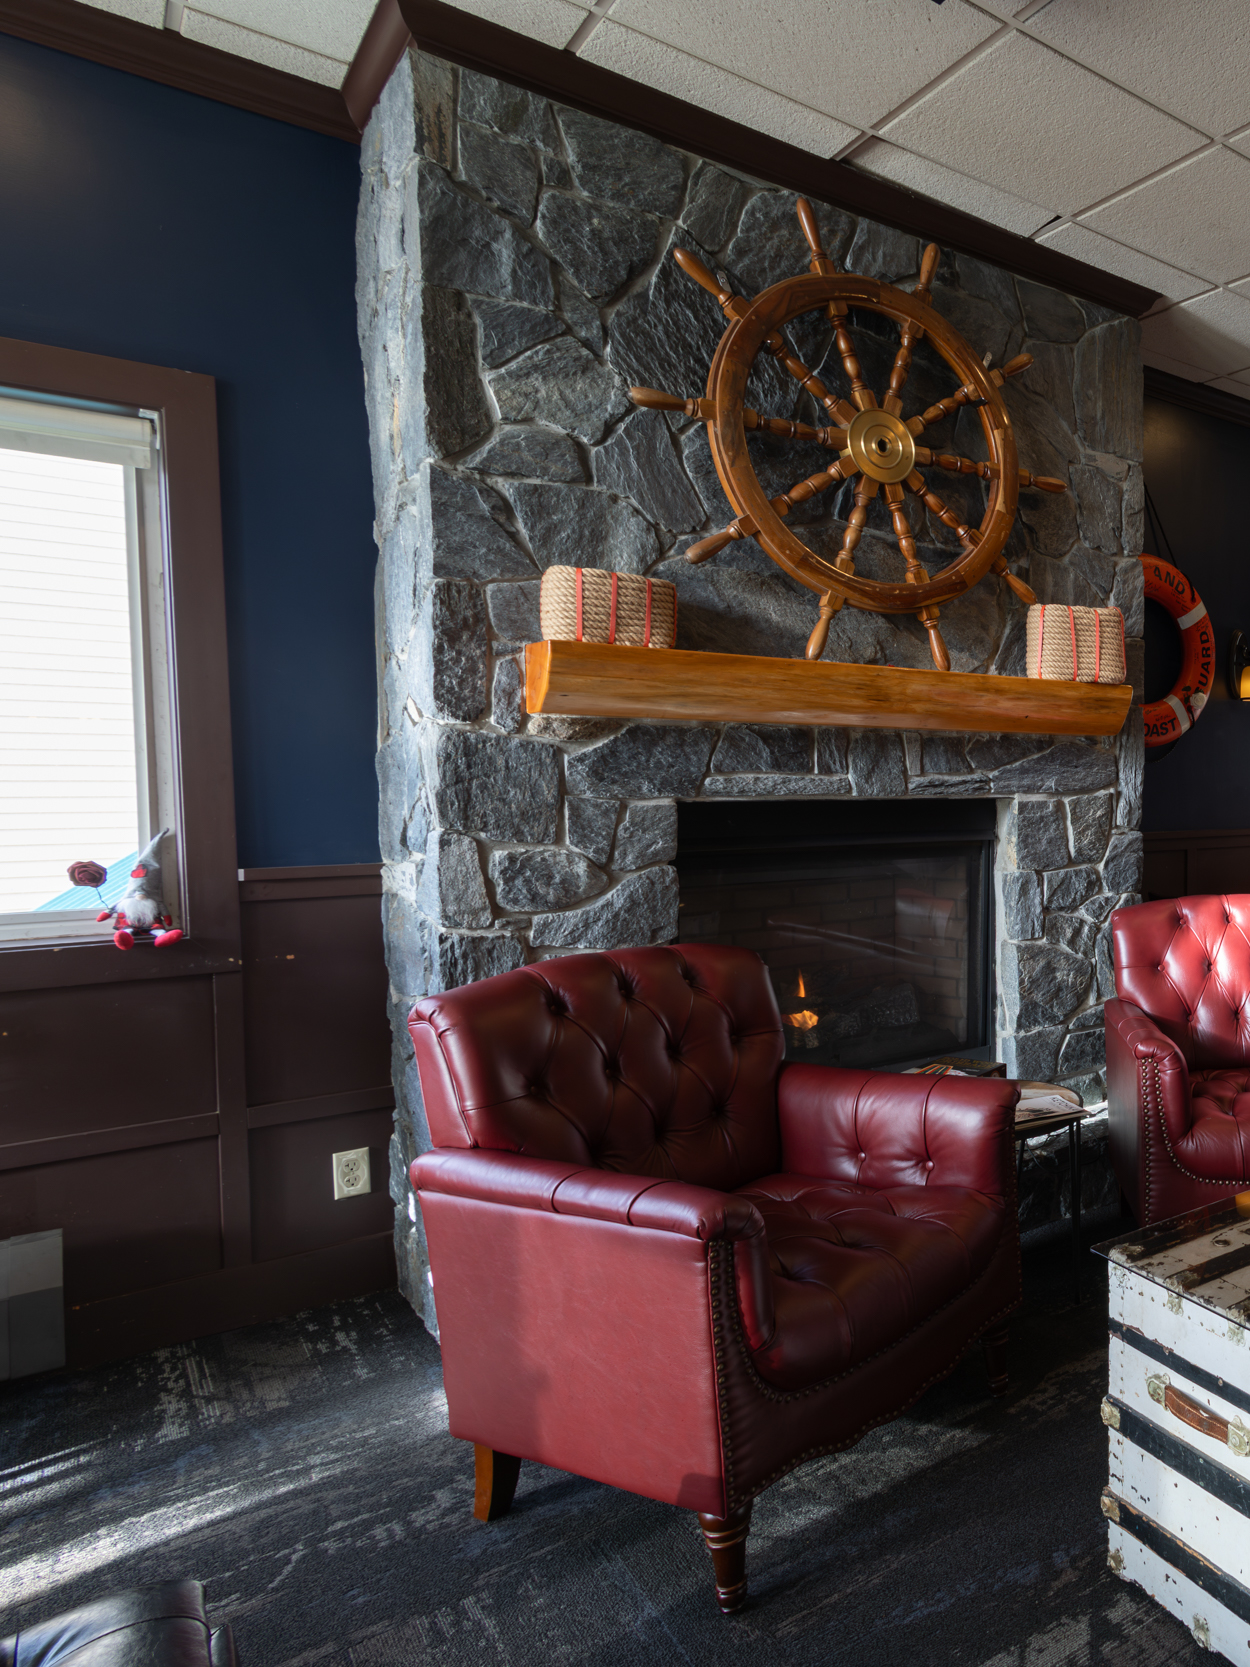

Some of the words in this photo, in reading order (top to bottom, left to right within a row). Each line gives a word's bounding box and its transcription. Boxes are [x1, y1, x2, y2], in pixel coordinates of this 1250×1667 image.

[1154, 566, 1185, 595] AND
[1144, 717, 1176, 737] OAST
[1195, 631, 1211, 693] UARD
